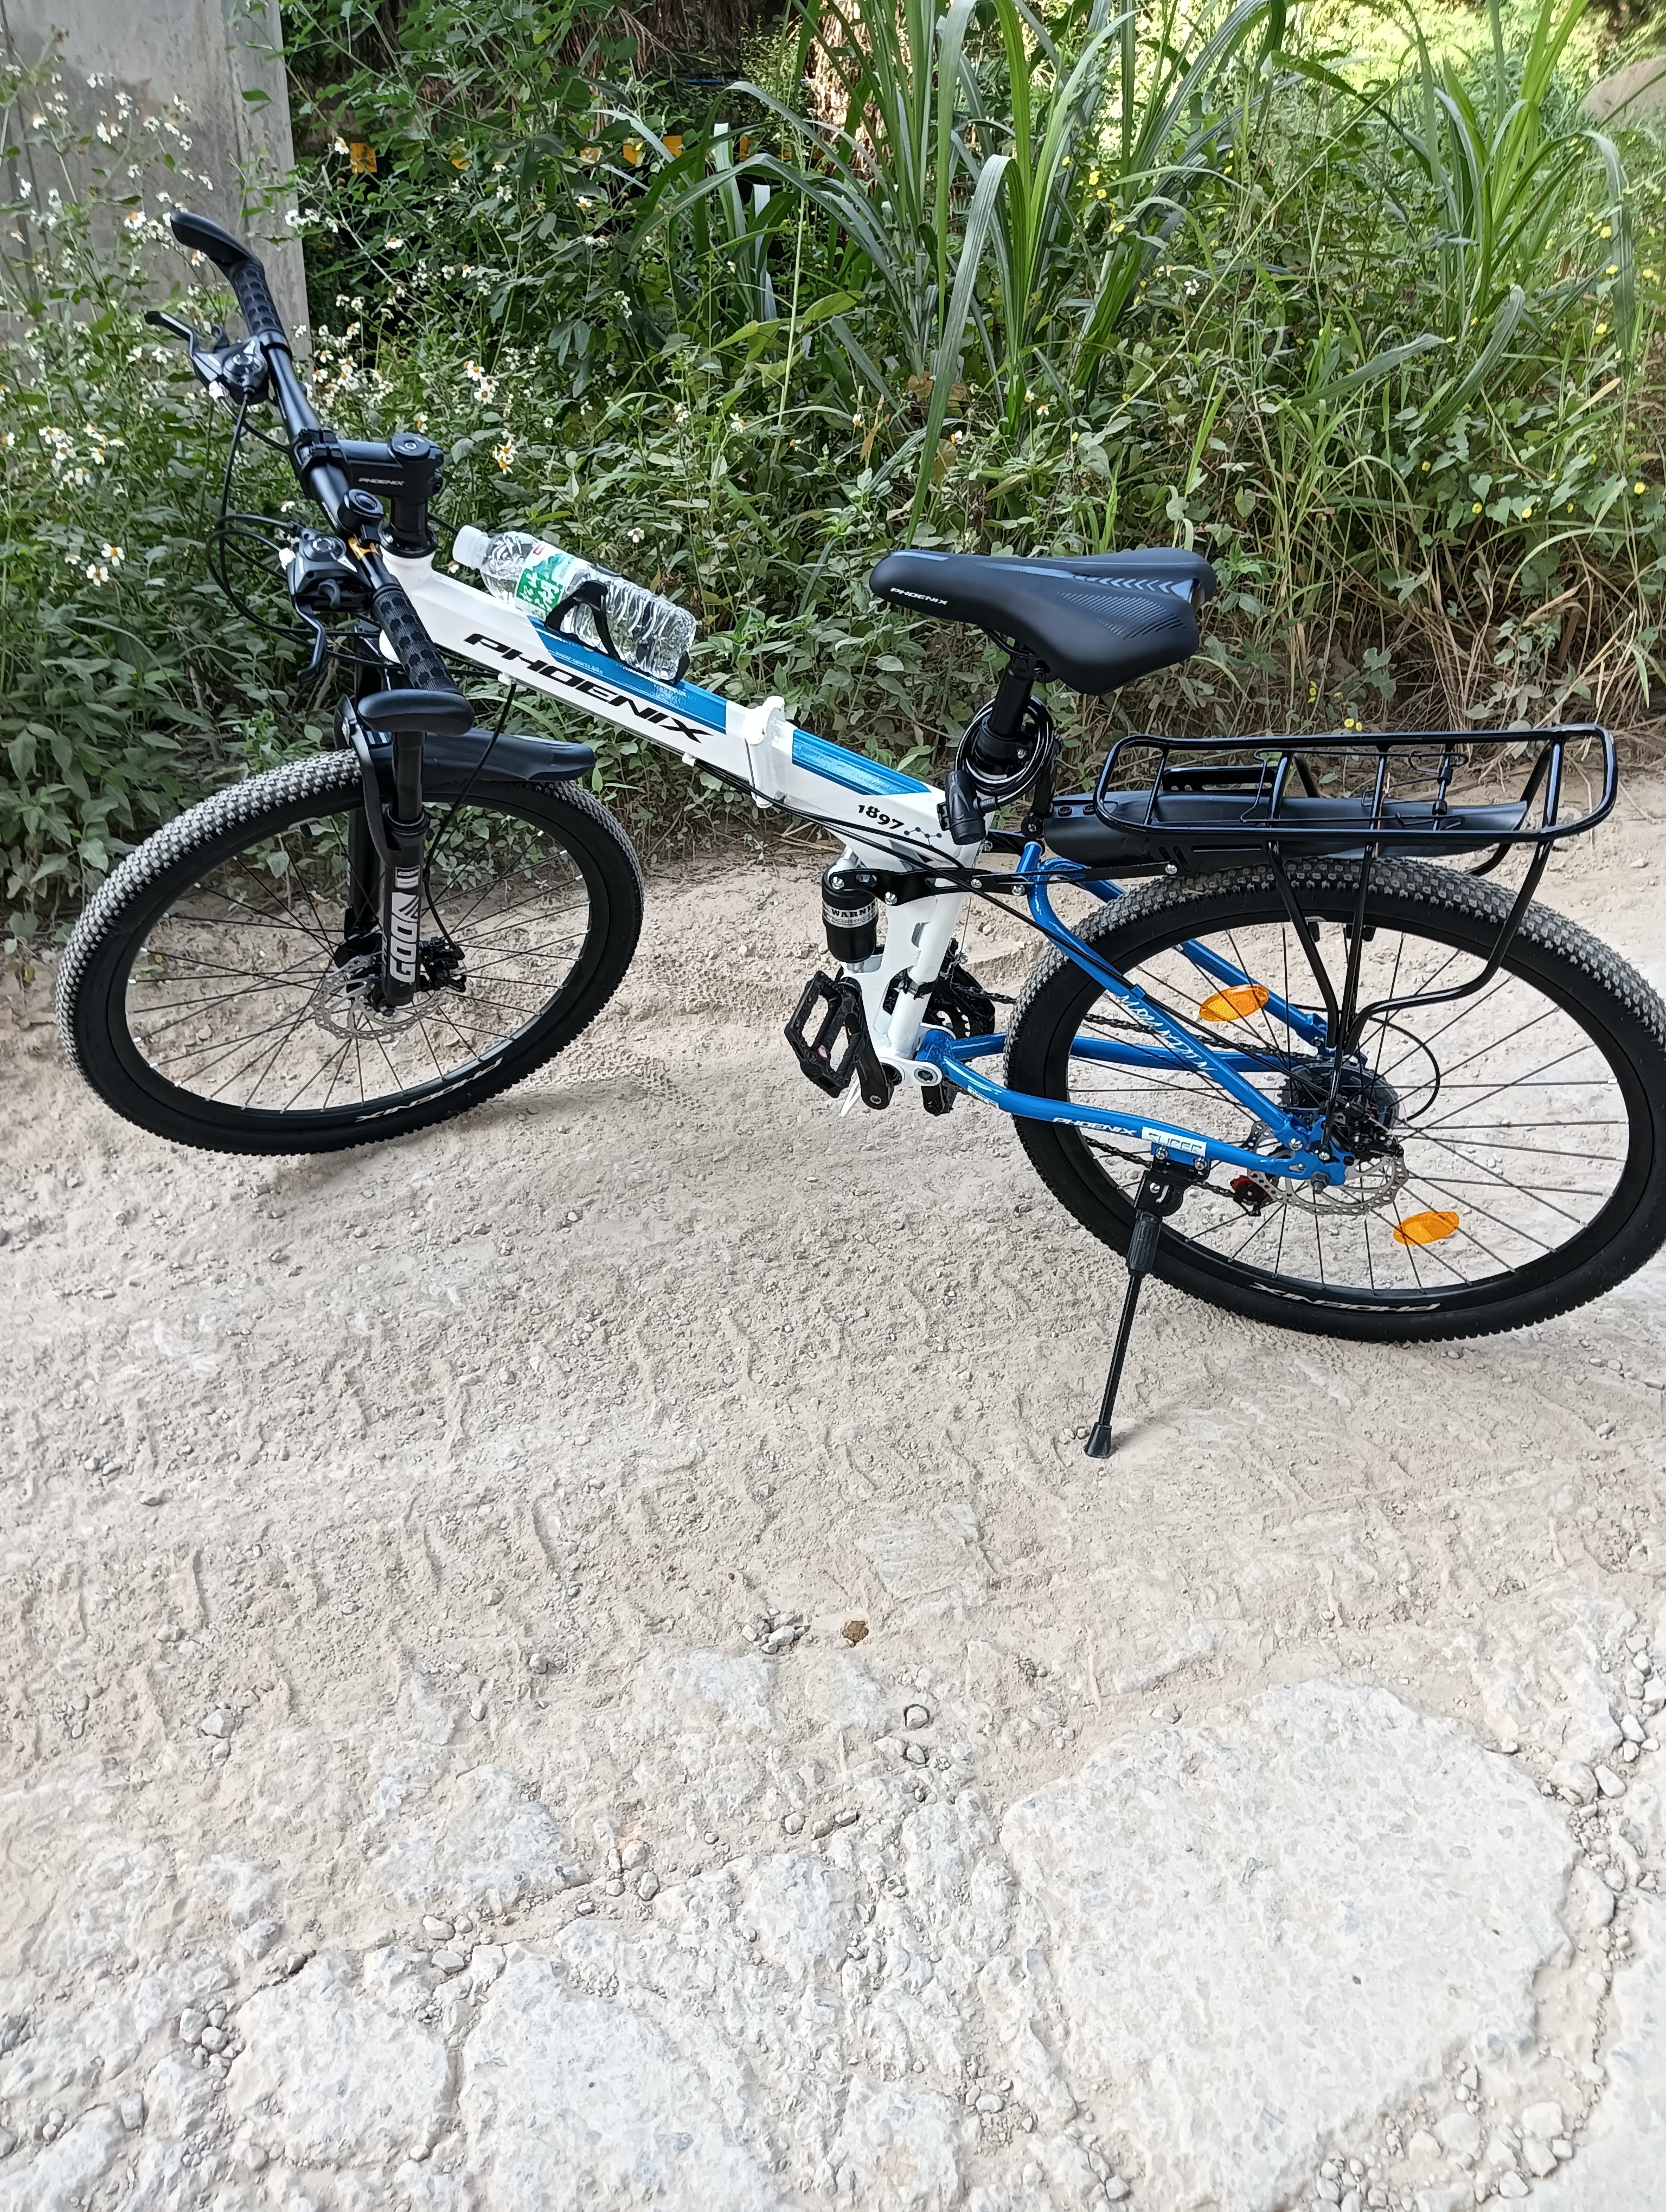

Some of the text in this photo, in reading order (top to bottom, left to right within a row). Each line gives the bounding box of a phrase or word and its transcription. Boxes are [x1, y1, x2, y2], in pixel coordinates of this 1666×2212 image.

[890, 588, 948, 605] PHOENIX
[463, 633, 714, 744] PHOENIX
[858, 805, 905, 829] 1897
[831, 901, 876, 918] WARNIN
[1052, 1117, 1202, 1153] PHOENIX SUPER
[1248, 1281, 1441, 1313] PHOENIX
